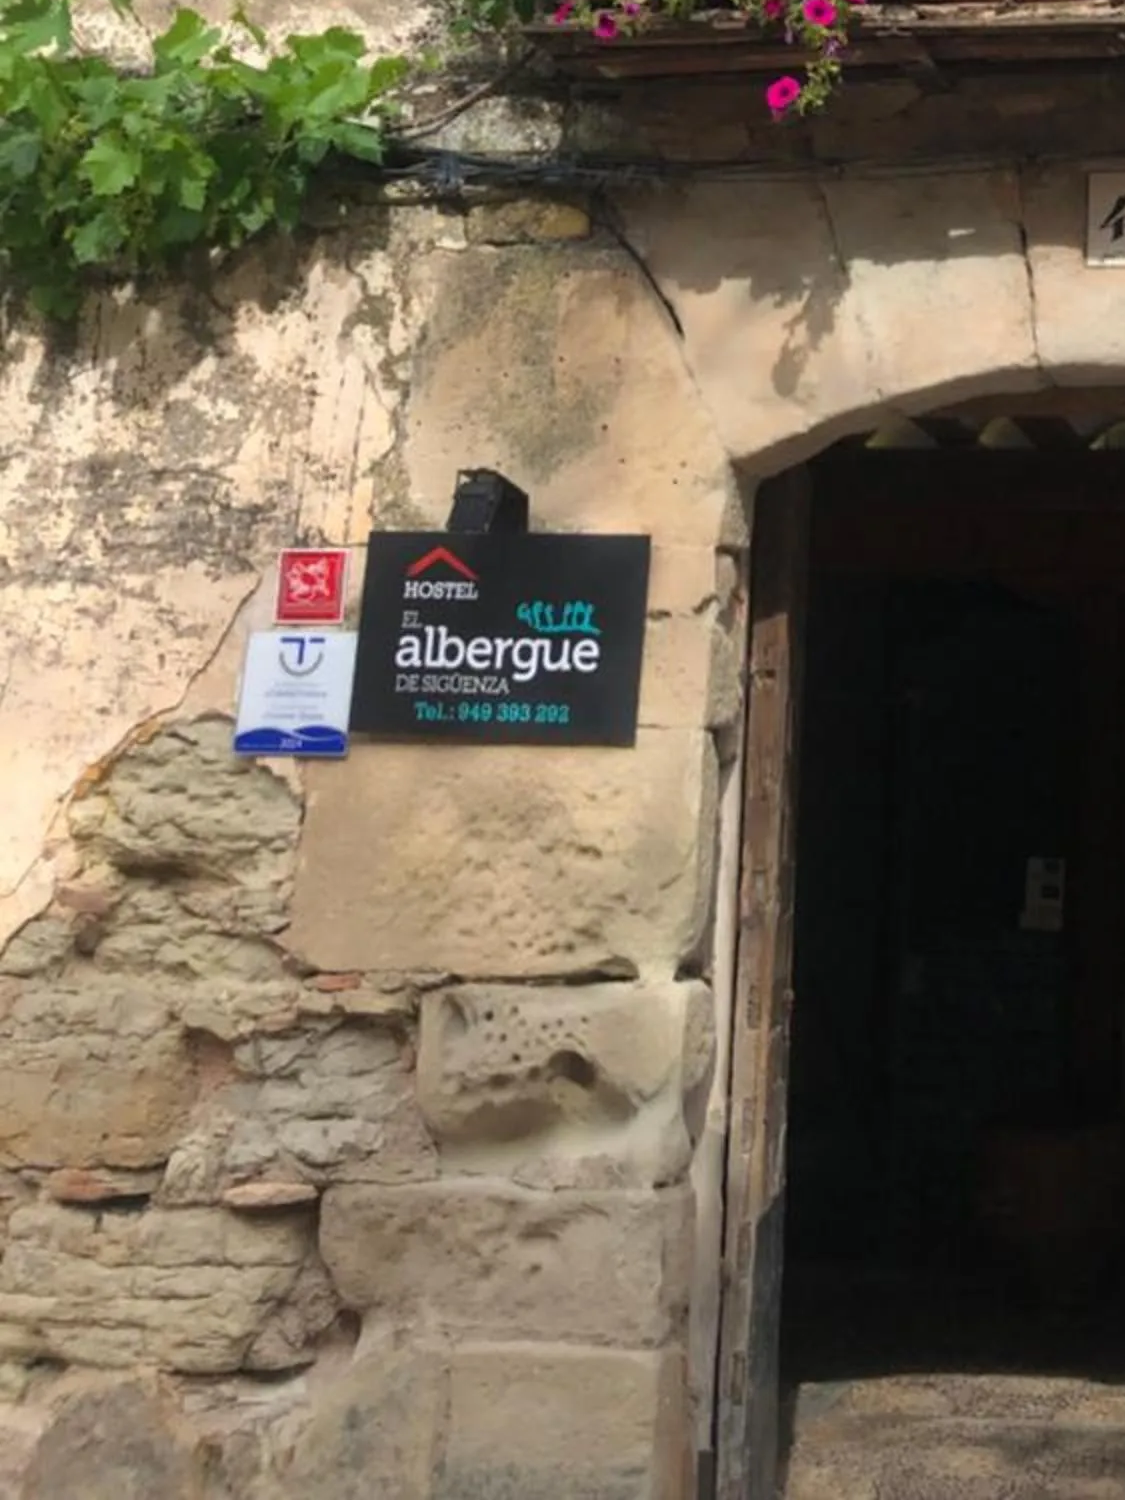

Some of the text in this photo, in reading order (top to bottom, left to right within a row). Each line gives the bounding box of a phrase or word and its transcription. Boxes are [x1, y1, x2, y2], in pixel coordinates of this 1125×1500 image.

[402, 581, 479, 600] HOSTEL
[401, 610, 422, 629] EL
[395, 625, 600, 681] albergue
[395, 674, 510, 695] DE SIGÜENZA
[457, 701, 493, 722] 949
